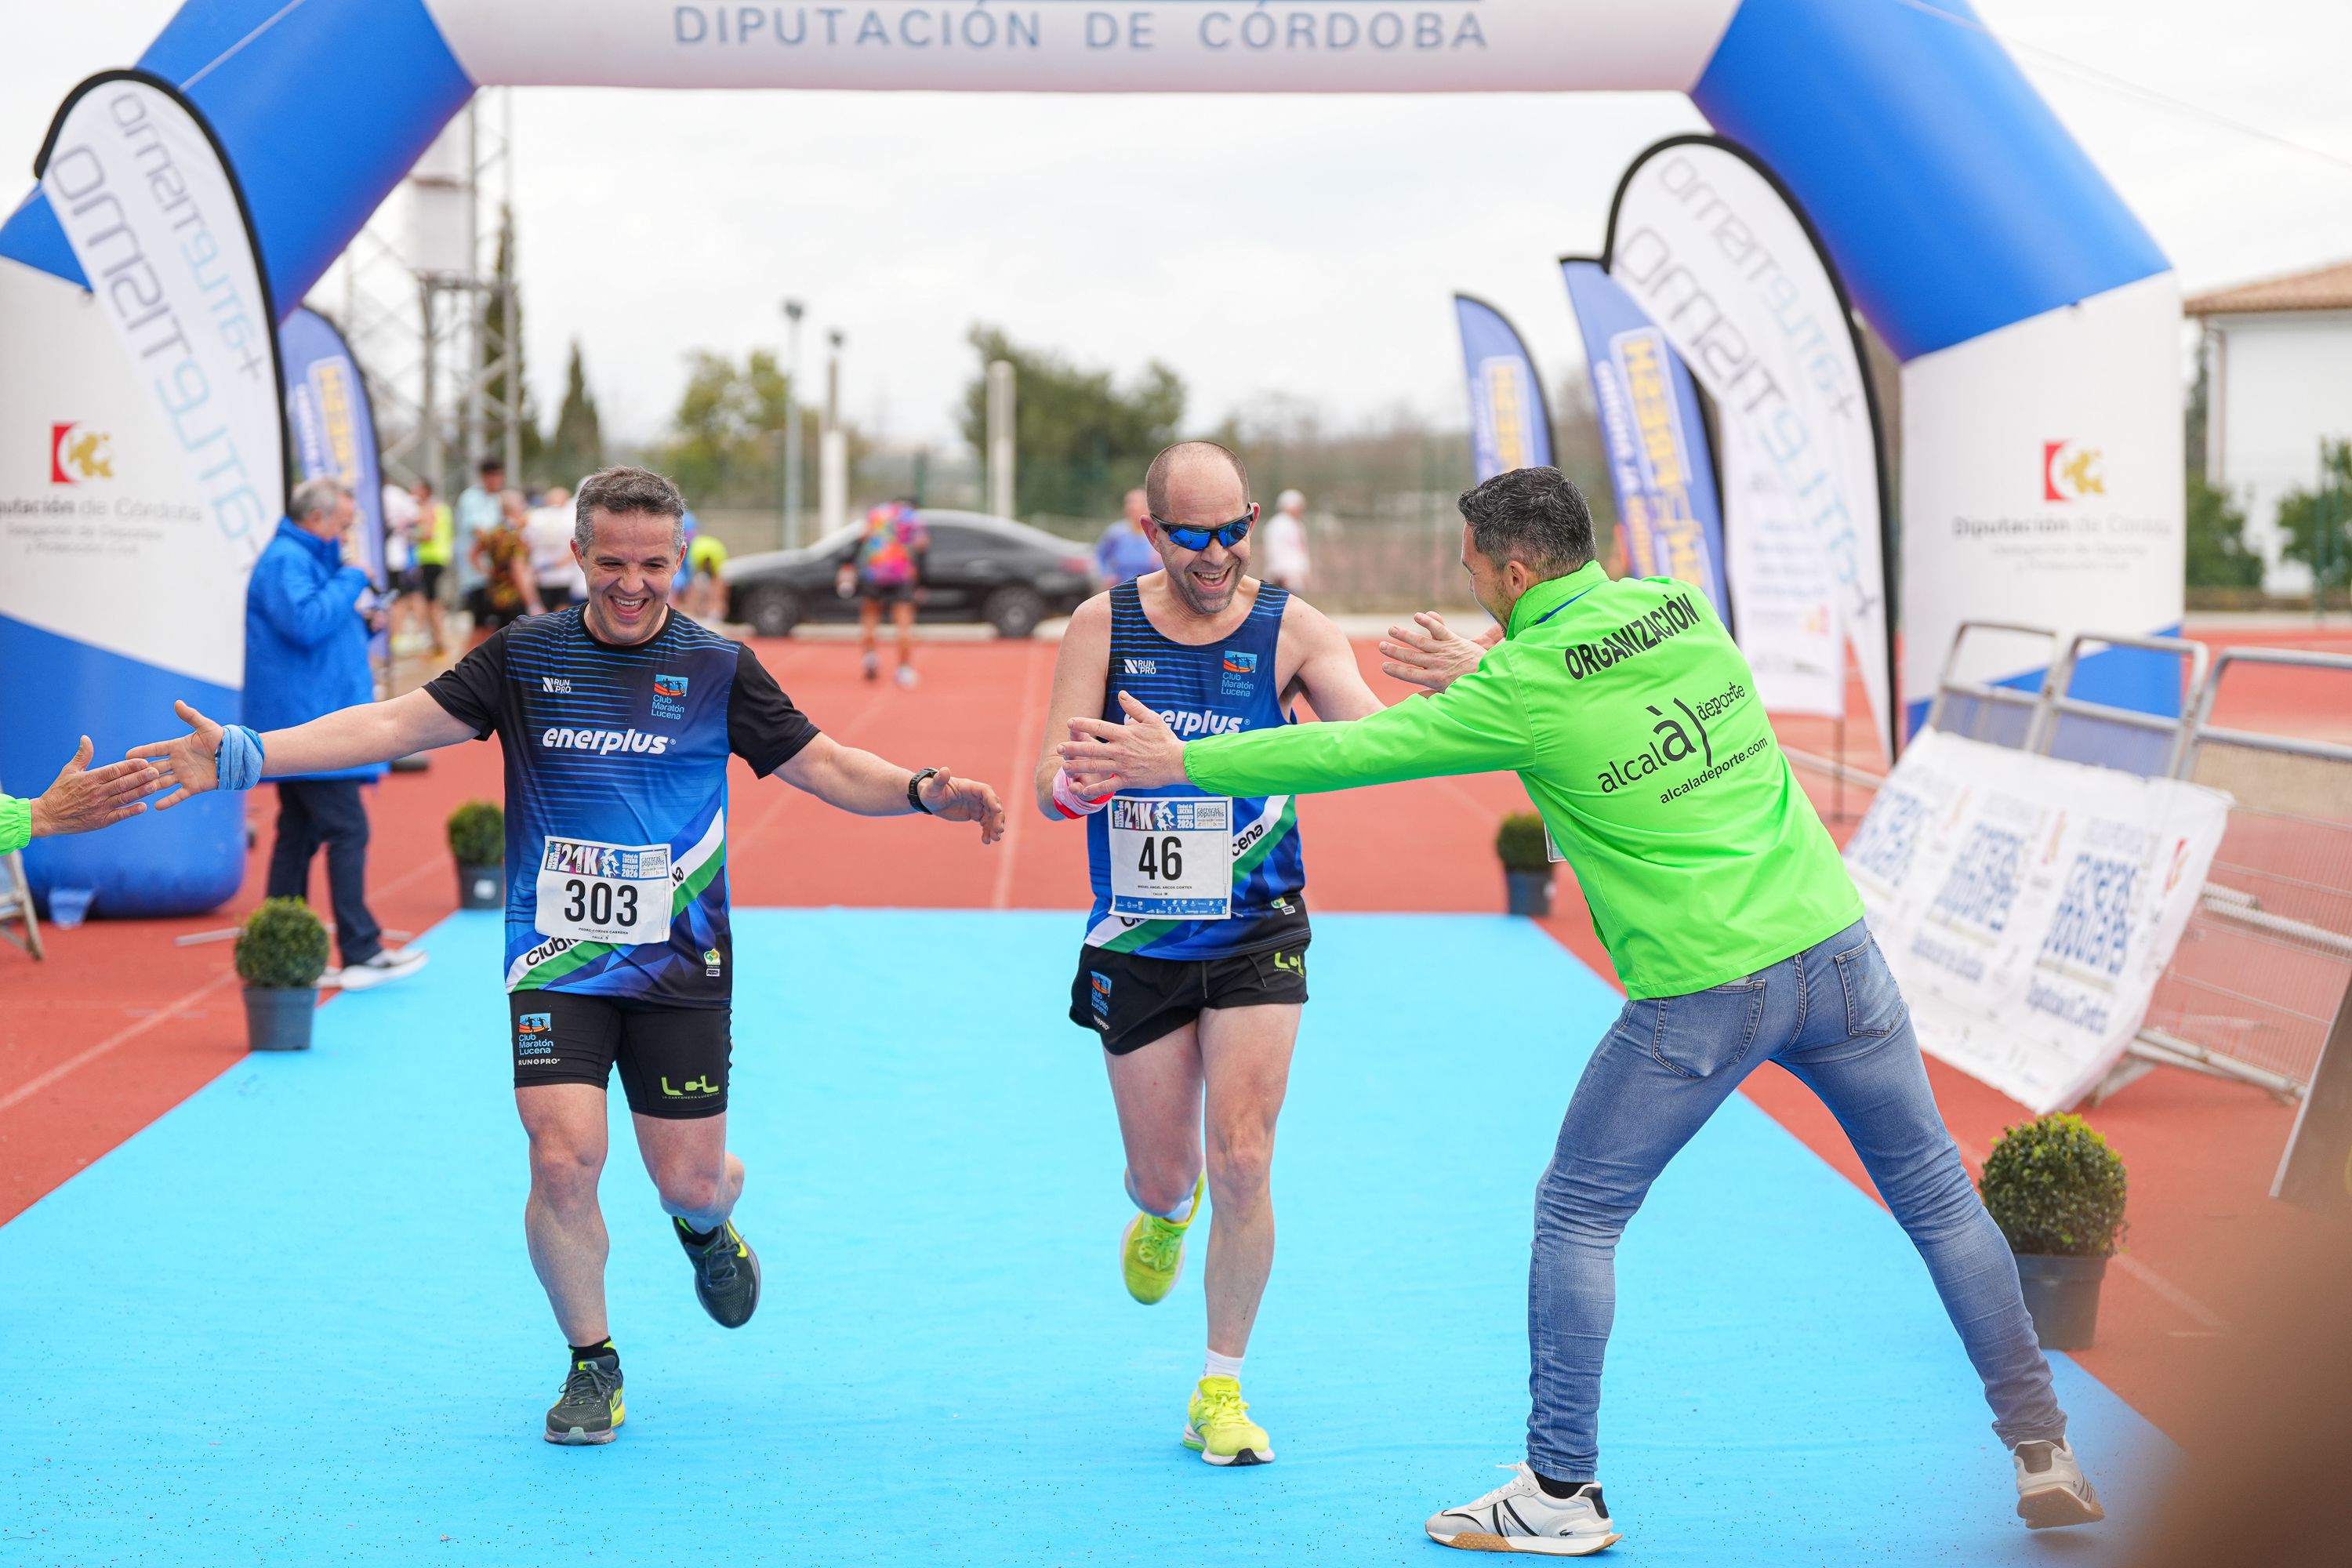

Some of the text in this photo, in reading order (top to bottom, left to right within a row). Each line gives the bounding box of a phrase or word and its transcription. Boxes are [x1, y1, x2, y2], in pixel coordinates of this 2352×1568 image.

[673, 0, 1487, 50] DIPUTACIÓN DE CÓRDOBA
[1140, 666, 1156, 675] PRO
[554, 678, 571, 687] RUN
[1221, 680, 1254, 690] Maratón
[555, 685, 572, 694] PRO
[1221, 688, 1250, 697] Lucena
[653, 694, 672, 704] Club
[652, 702, 684, 713] Maratón
[651, 710, 681, 720] Lucena
[1660, 737, 1769, 804] alcaladeporte.com
[1124, 801, 1153, 830] 21K
[1177, 820, 1193, 829] 2026
[558, 844, 600, 875] 21K
[1138, 837, 1182, 880] 46
[621, 869, 638, 877] 2026
[564, 879, 638, 927] 303
[519, 1039, 554, 1048] Maratón
